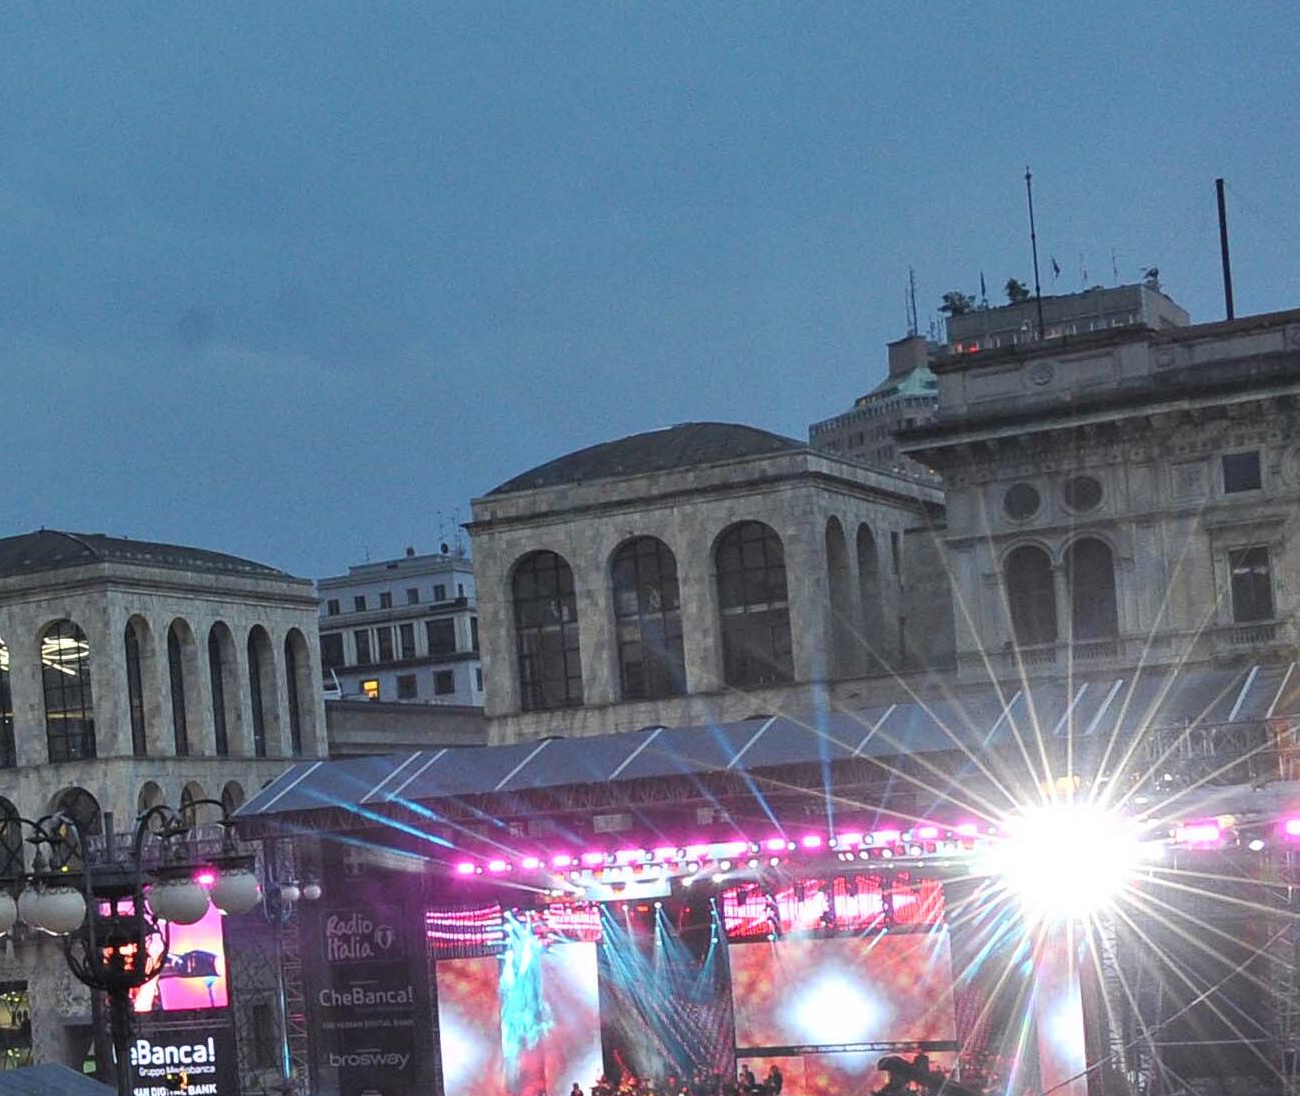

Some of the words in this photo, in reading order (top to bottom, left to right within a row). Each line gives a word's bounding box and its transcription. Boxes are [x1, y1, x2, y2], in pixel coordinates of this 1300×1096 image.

[325, 914, 373, 937] Radio
[328, 936, 375, 961] Italia
[319, 986, 414, 1007] CheBanca!
[329, 1053, 410, 1070] brosway
[139, 1067, 165, 1078] Gruppo
[188, 1083, 217, 1096] BANK
